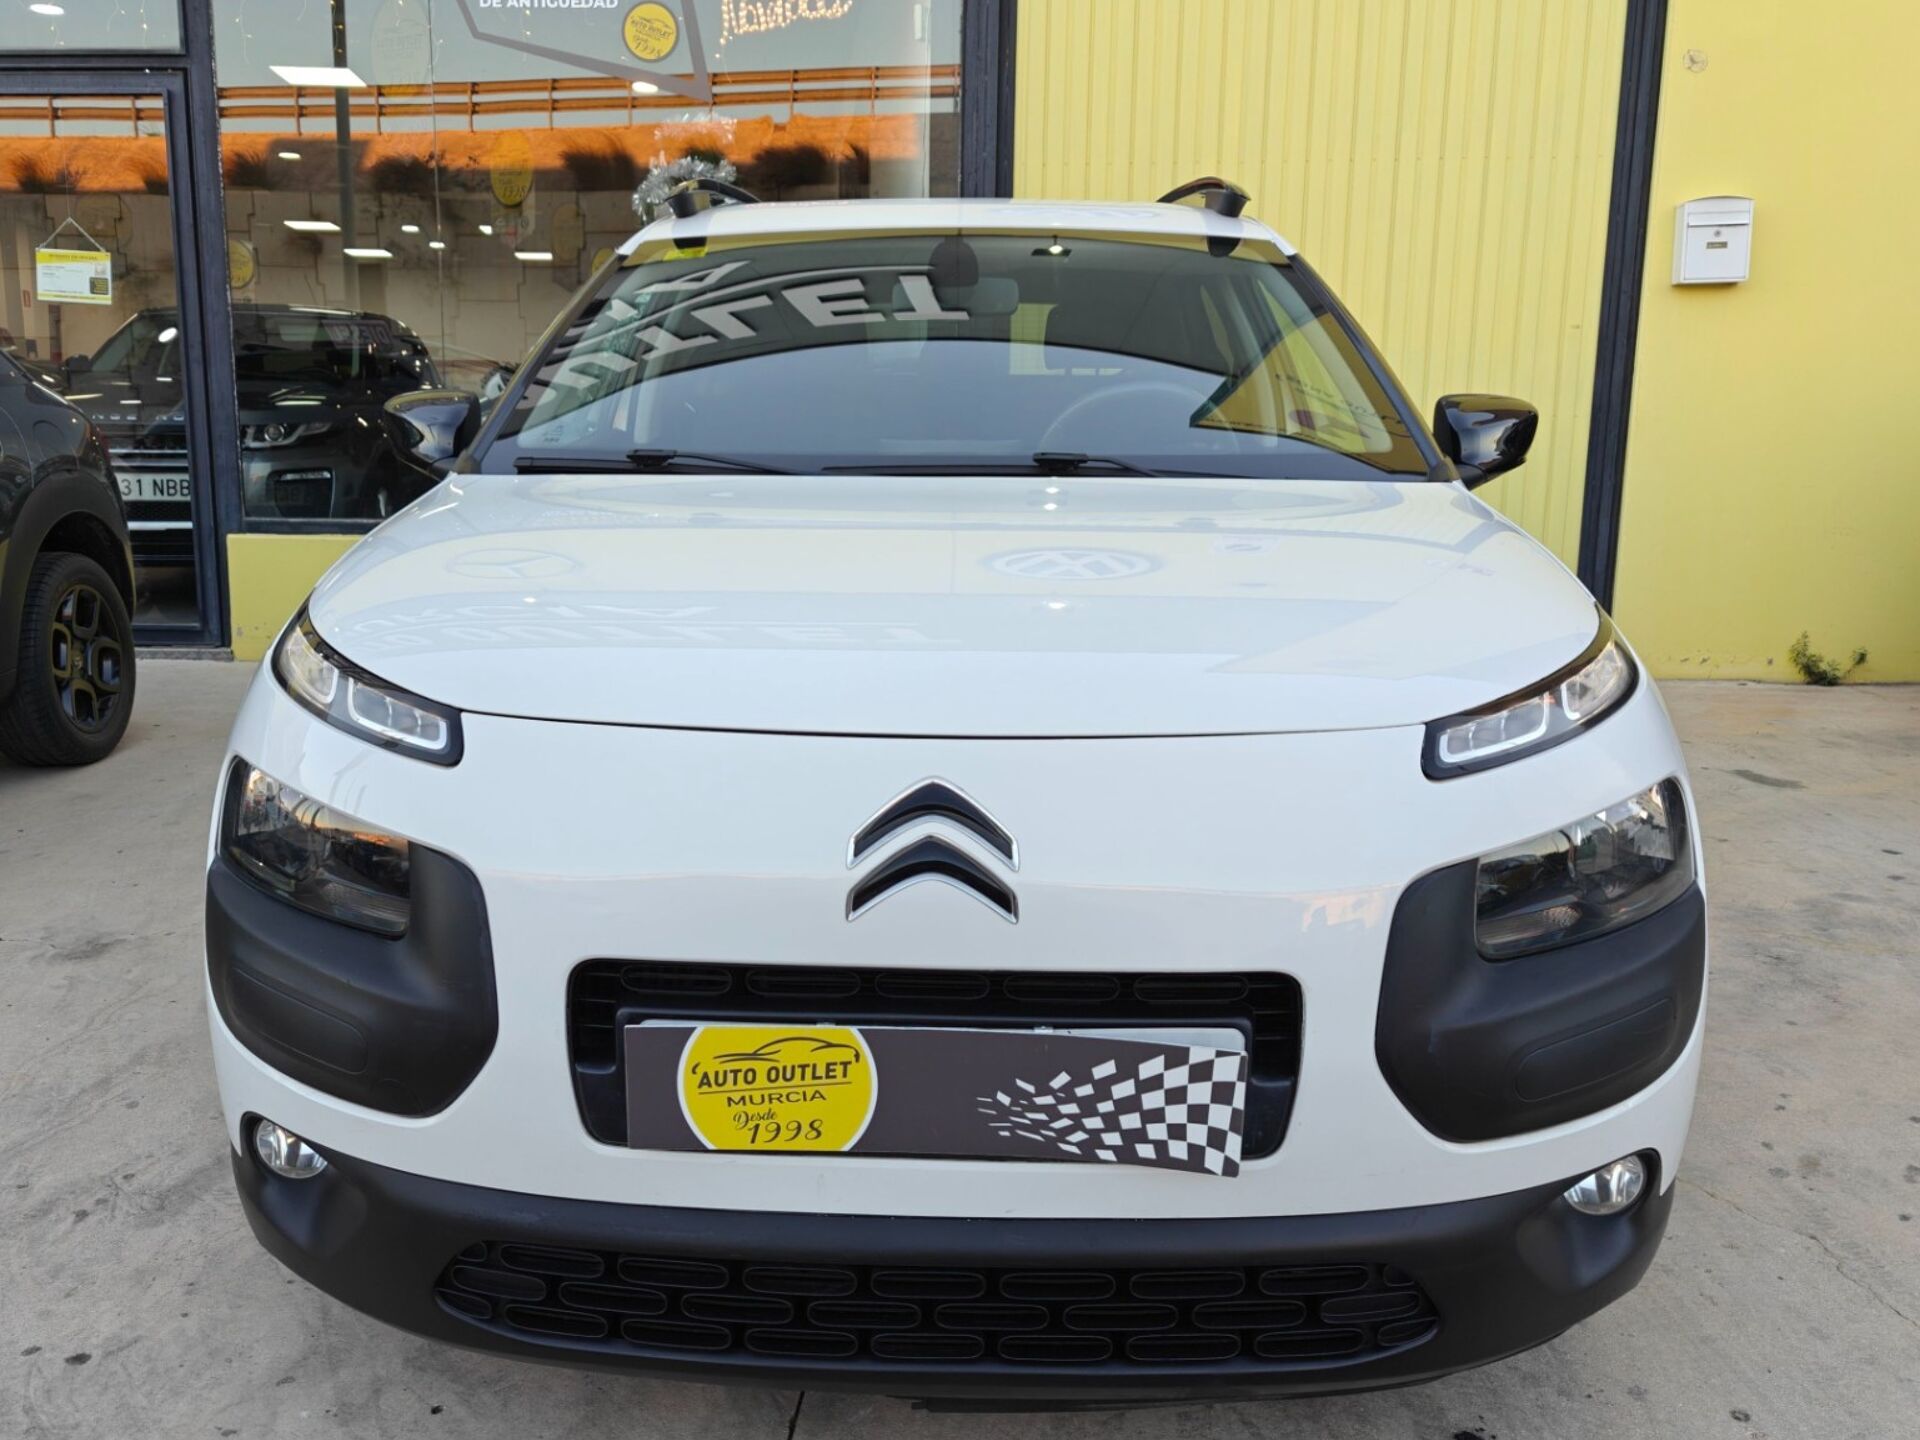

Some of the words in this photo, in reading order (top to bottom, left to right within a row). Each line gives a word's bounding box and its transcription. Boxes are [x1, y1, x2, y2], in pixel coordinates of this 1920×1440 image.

[152, 478, 190, 496] NBB
[697, 1068, 757, 1089] AUTO
[766, 1061, 852, 1084] OUTLET
[726, 1090, 827, 1108] MURCIA
[732, 1108, 778, 1130] Desde
[747, 1118, 824, 1144] 1998
